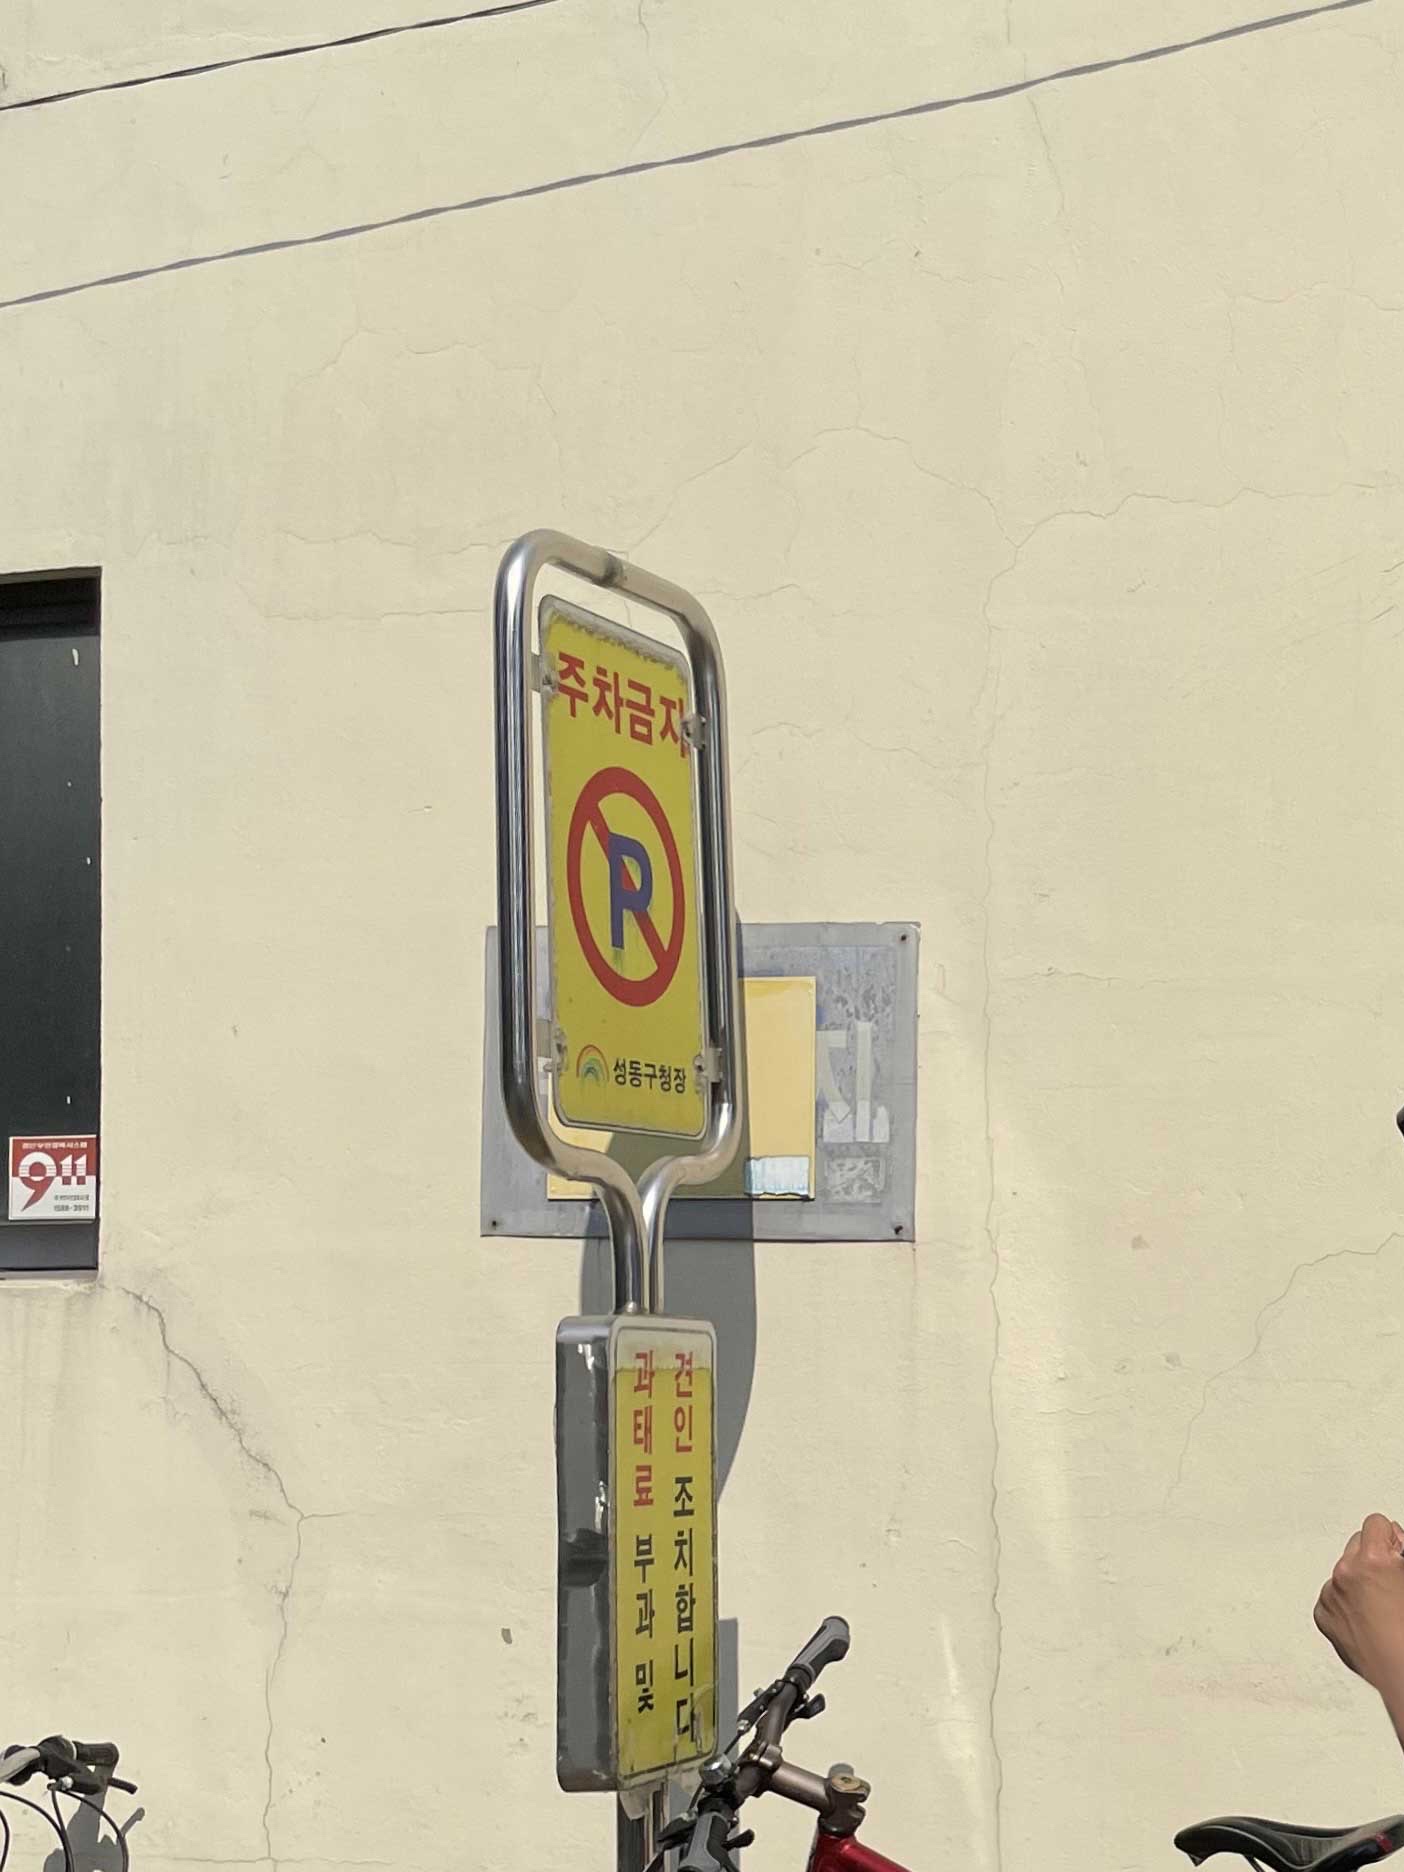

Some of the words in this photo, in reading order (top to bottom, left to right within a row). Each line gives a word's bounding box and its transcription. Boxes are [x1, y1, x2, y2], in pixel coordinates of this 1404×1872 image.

[558, 651, 688, 758] 주차금지
[608, 830, 653, 950] P
[613, 1058, 686, 1093] 성동구청장
[19, 1151, 87, 1212] 911
[633, 1349, 655, 1507] 과태료
[673, 1351, 694, 1453] 견인
[634, 1533, 656, 1638] 부과
[673, 1476, 696, 1742] 조치합니다
[636, 1659, 654, 1713] 및
